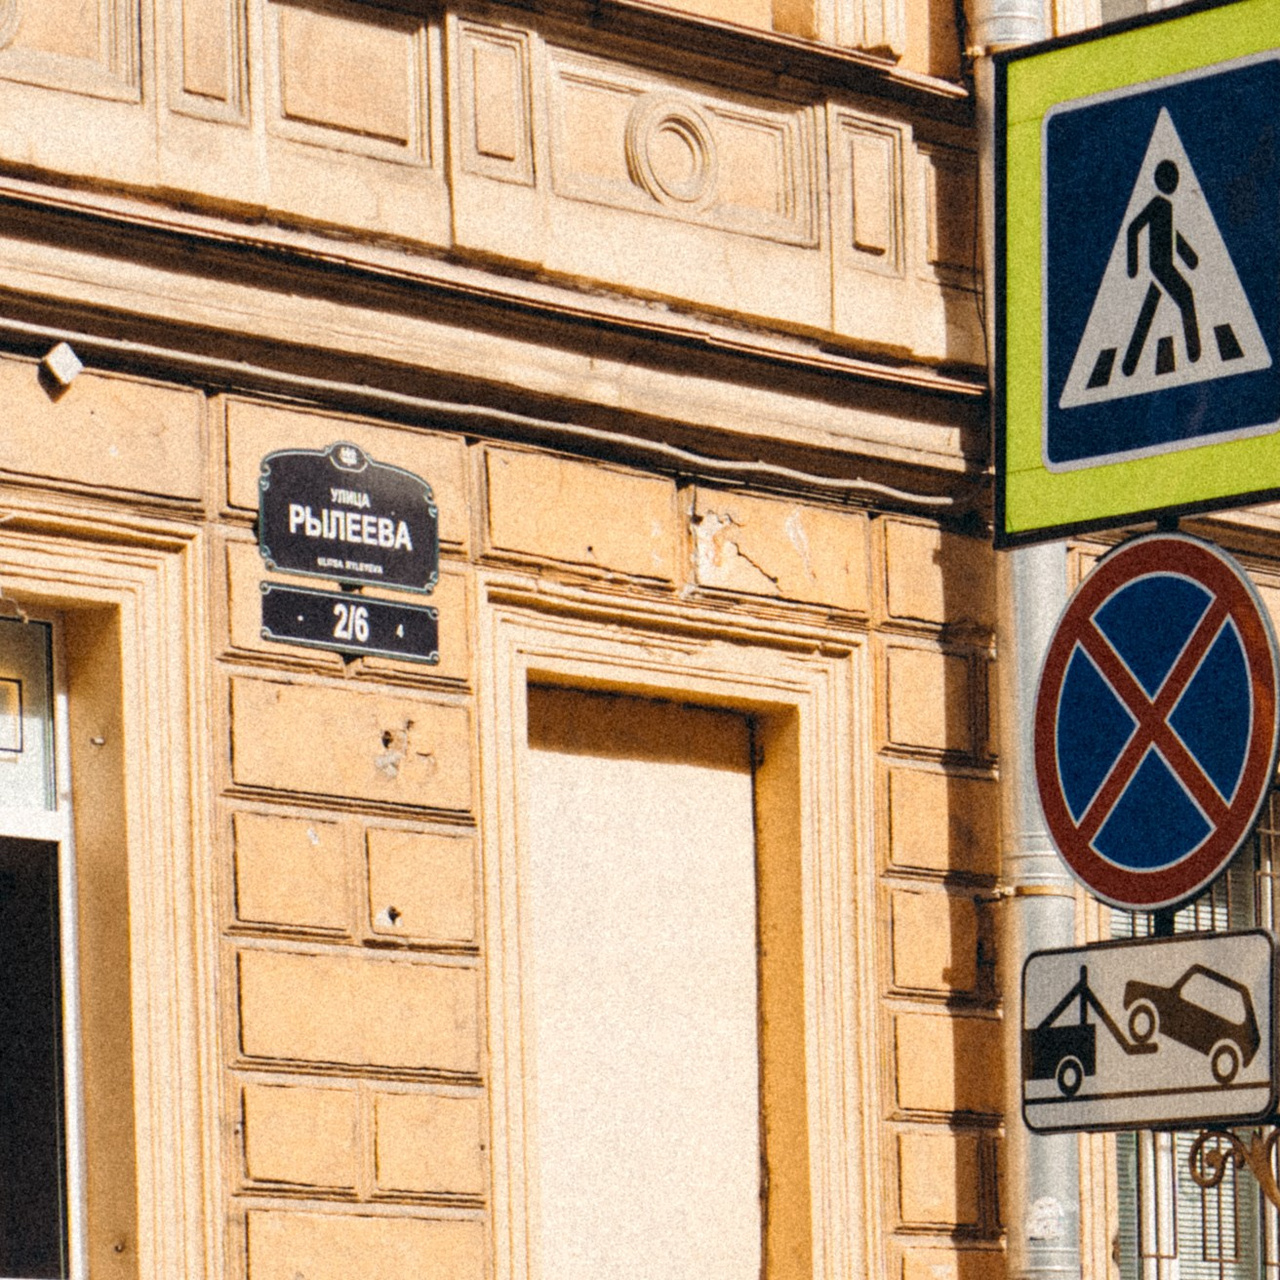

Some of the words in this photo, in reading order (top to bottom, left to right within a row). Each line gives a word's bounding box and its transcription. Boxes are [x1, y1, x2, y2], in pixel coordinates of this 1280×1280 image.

[330, 488, 371, 508] УЛИЦА
[289, 504, 413, 551] РЫЛЕЕВА
[333, 603, 370, 641] 2/6
